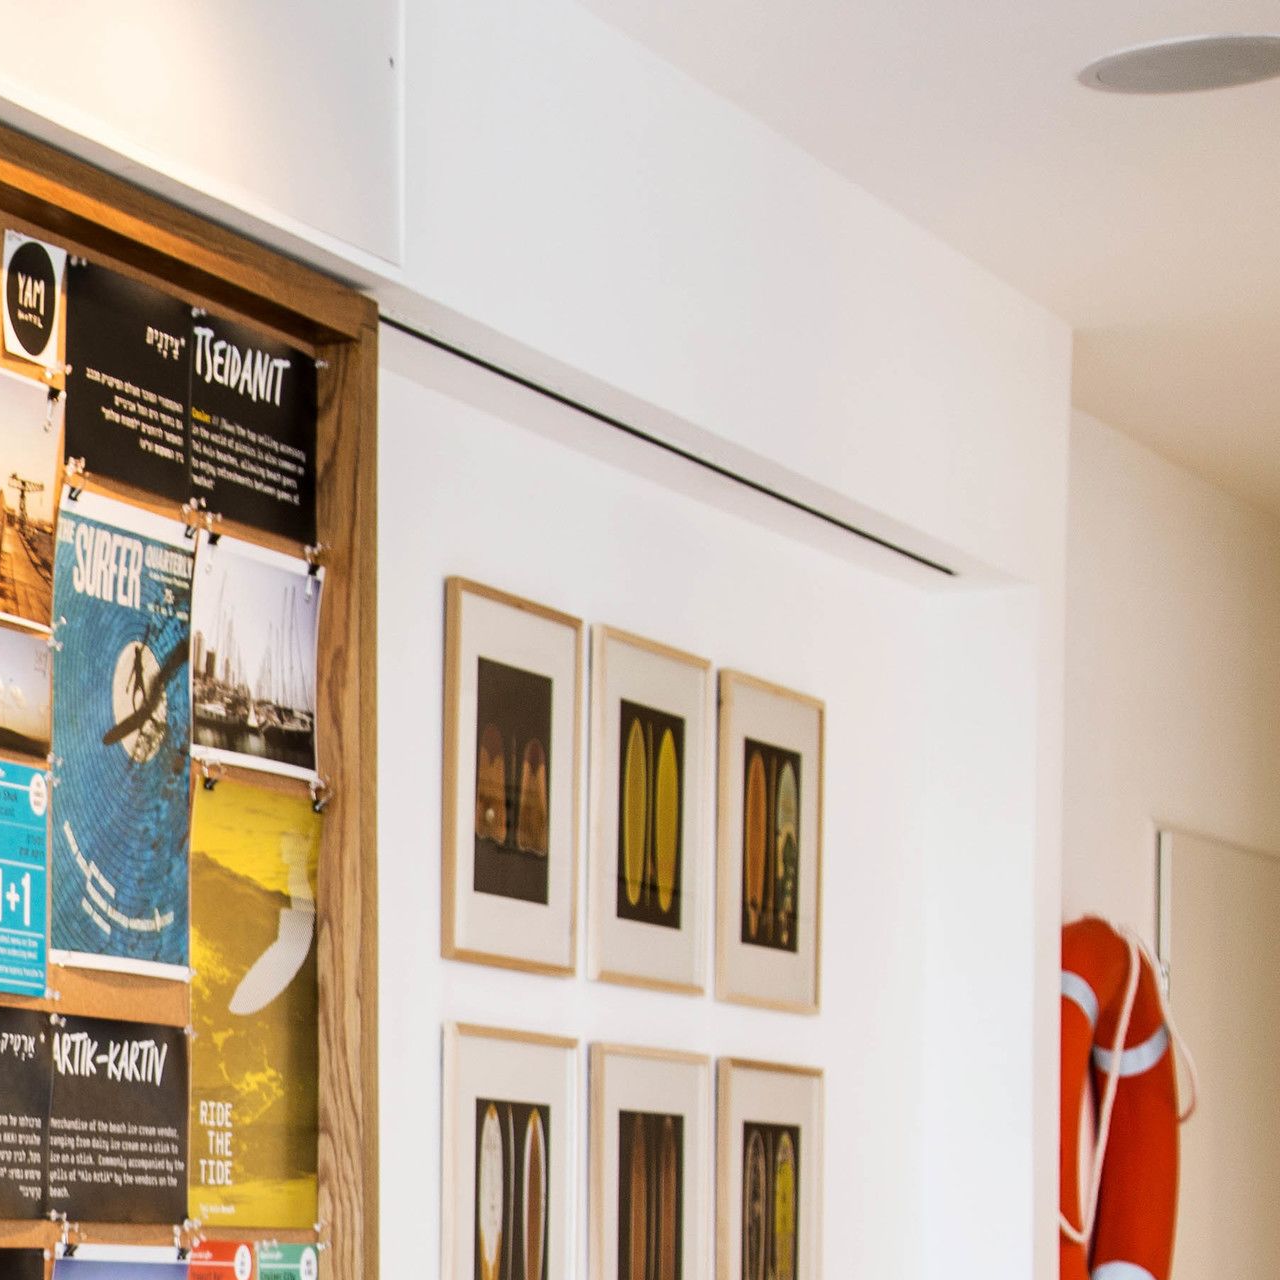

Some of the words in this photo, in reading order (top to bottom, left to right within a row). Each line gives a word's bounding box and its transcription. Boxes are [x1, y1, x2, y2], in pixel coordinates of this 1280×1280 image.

[17, 270, 46, 317] YAM
[193, 326, 291, 407] TSEIDANIT
[57, 518, 77, 545] THE
[72, 522, 144, 611] SURFER
[52, 1031, 168, 1087] ARTIK-KARTIV
[199, 1099, 234, 1128] RIDE
[207, 1129, 234, 1157] THE
[199, 1158, 233, 1186] TIDE
